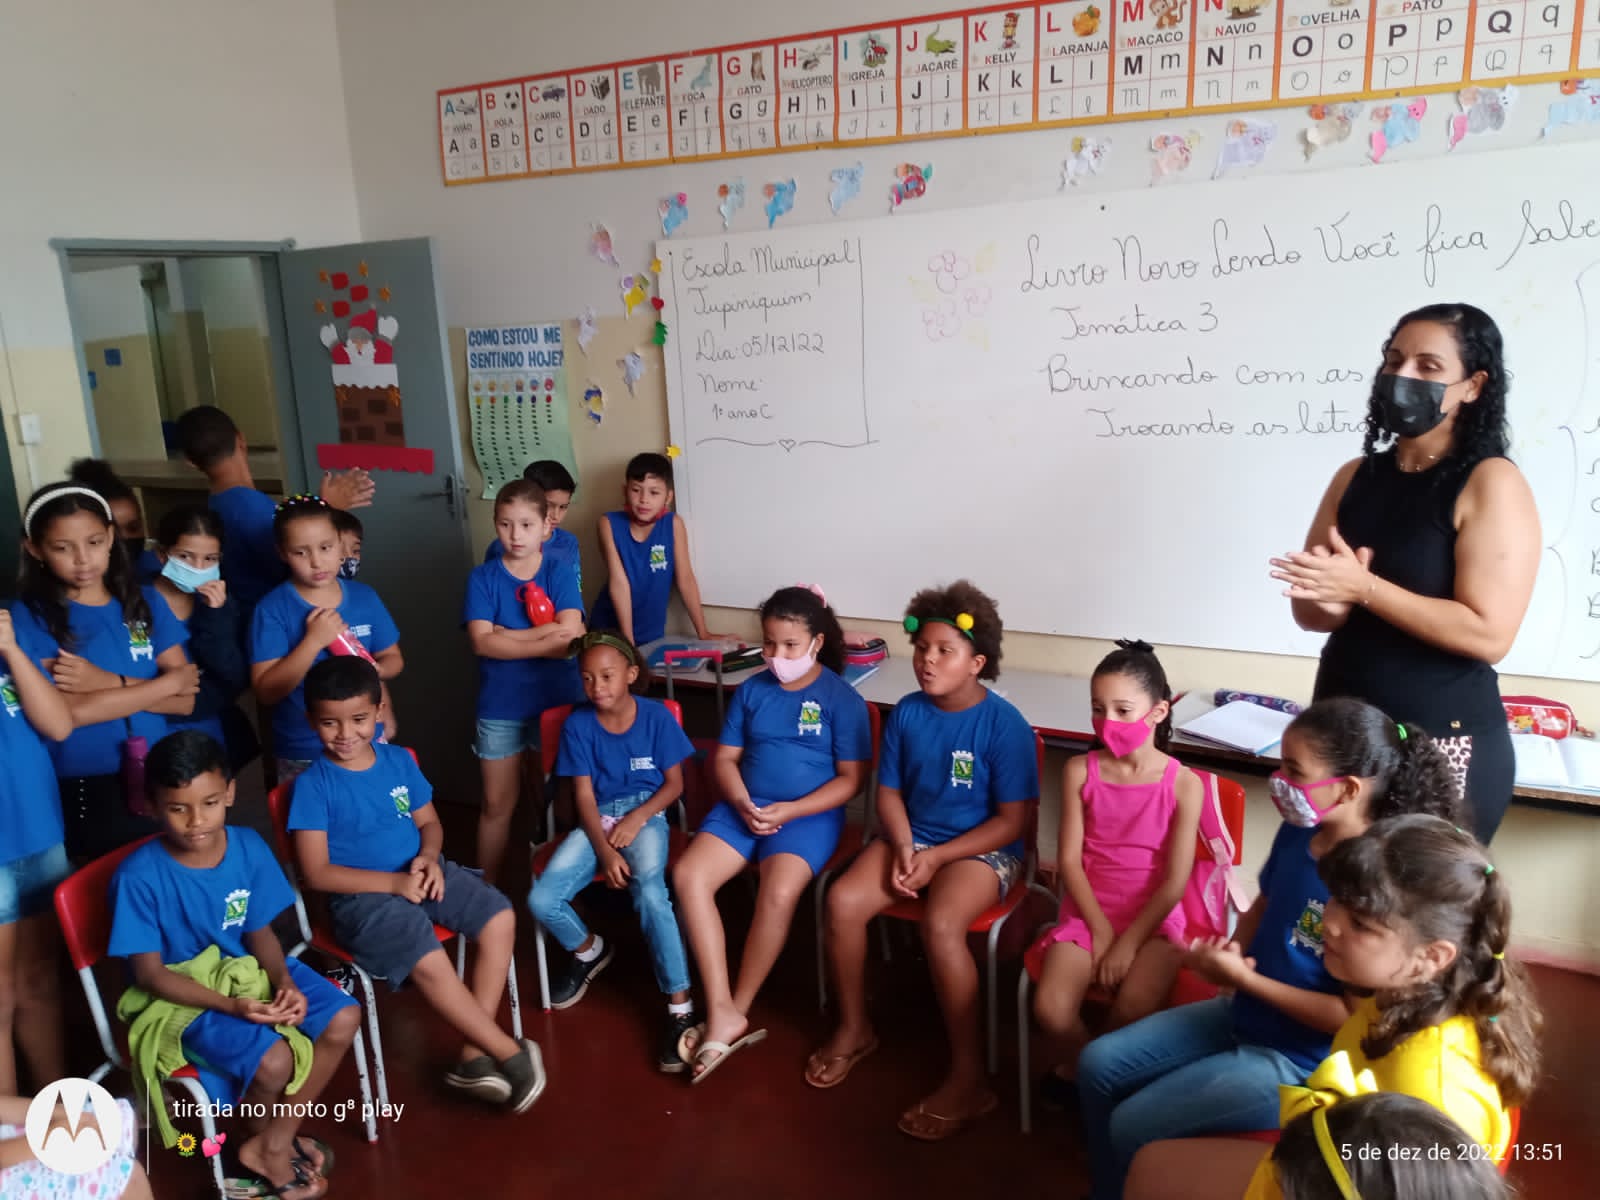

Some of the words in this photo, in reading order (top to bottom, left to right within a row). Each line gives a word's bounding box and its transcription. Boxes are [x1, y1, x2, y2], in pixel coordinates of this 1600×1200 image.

[1122, 0, 1144, 23] M
[1300, 8, 1361, 26] OVELHA
[1488, 9, 1512, 35] Q
[1542, 4, 1560, 28] q
[974, 20, 987, 43] K
[1046, 11, 1061, 33] L
[1215, 22, 1256, 37] NAVIO
[1388, 23, 1408, 47] P
[1436, 17, 1453, 41] p
[906, 30, 918, 52] J
[1052, 40, 1109, 57] LARANJA
[1127, 31, 1184, 48] MACACO
[1292, 35, 1313, 57] O
[1338, 32, 1353, 50] o
[783, 47, 797, 69] H
[843, 39, 848, 61] I
[985, 51, 1017, 65] KELLY
[1207, 45, 1224, 67] N
[1248, 43, 1262, 61] n
[673, 64, 684, 84] F
[726, 56, 741, 76] G
[915, 58, 959, 74] JACARÉ
[1050, 64, 1063, 84] L
[1123, 55, 1143, 76] M
[1160, 52, 1181, 70] m
[622, 71, 634, 90] E
[848, 68, 885, 81] IGREJA
[978, 72, 990, 92] K
[1011, 69, 1023, 88] k
[529, 86, 540, 104] C
[574, 79, 586, 97] D
[737, 85, 762, 97] GATO
[912, 79, 921, 100] J
[444, 99, 455, 117] A
[485, 93, 496, 110] B
[583, 104, 606, 115] DADO
[624, 95, 665, 110] ELEFANTE
[729, 102, 742, 120] G
[757, 99, 767, 117] g
[787, 95, 800, 115] H
[816, 92, 826, 112] h
[627, 115, 637, 133] E
[651, 114, 660, 127] e
[679, 109, 688, 127] F
[704, 105, 710, 124] f
[533, 127, 544, 143] C
[579, 121, 590, 137] D
[602, 119, 611, 136] d
[449, 138, 460, 153] A
[470, 137, 478, 149] a
[490, 133, 501, 148] B
[512, 130, 520, 146] b
[1020, 234, 1108, 293] Livro
[1112, 234, 1200, 282] Novo
[1313, 211, 1400, 263] Você
[1416, 204, 1489, 288] fica
[750, 239, 857, 288] Municipal
[1050, 303, 1187, 340] Temática
[1198, 301, 1219, 333] 3
[468, 328, 500, 347] COMO
[502, 327, 539, 346] ESTOU
[543, 326, 561, 345] ME
[470, 350, 525, 369] SENTINDO
[528, 349, 565, 368] HOJE?
[1037, 353, 1219, 395] Brincando
[1085, 407, 1235, 439] Trocando
